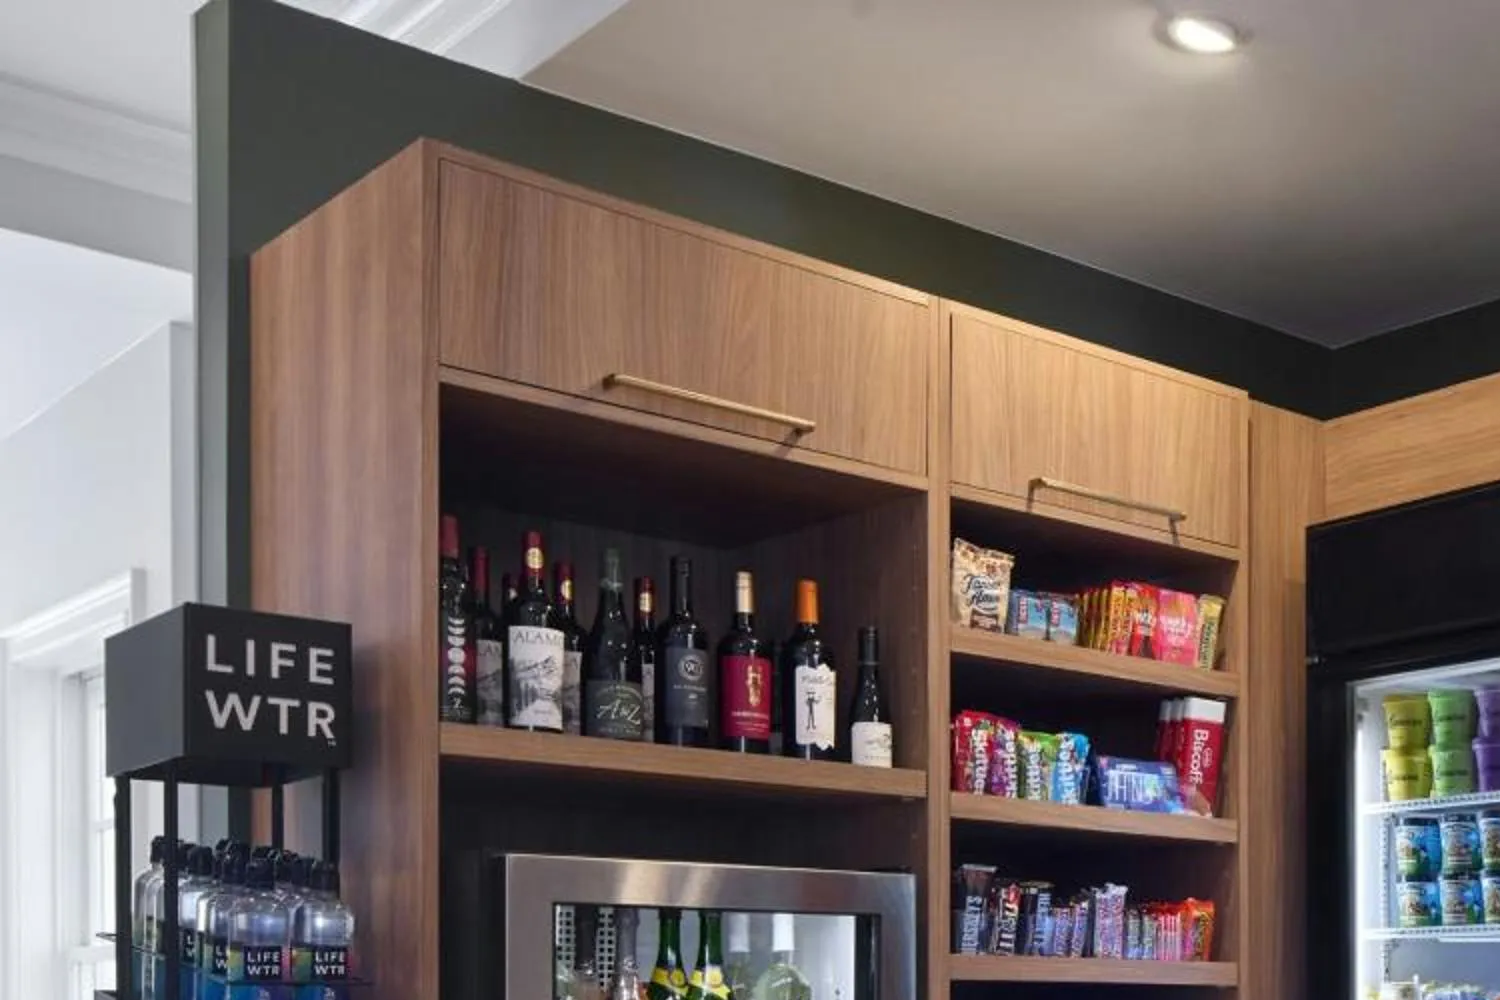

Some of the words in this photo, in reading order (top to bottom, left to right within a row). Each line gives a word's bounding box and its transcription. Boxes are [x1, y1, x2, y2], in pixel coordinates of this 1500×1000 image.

[206, 633, 335, 685] LIFE
[205, 689, 335, 739] WTR
[1188, 728, 1209, 785] Biscoff
[247, 951, 280, 963] LIFE
[315, 951, 345, 963] LIFE
[247, 964, 281, 977] WTR
[315, 964, 345, 976] WTR
